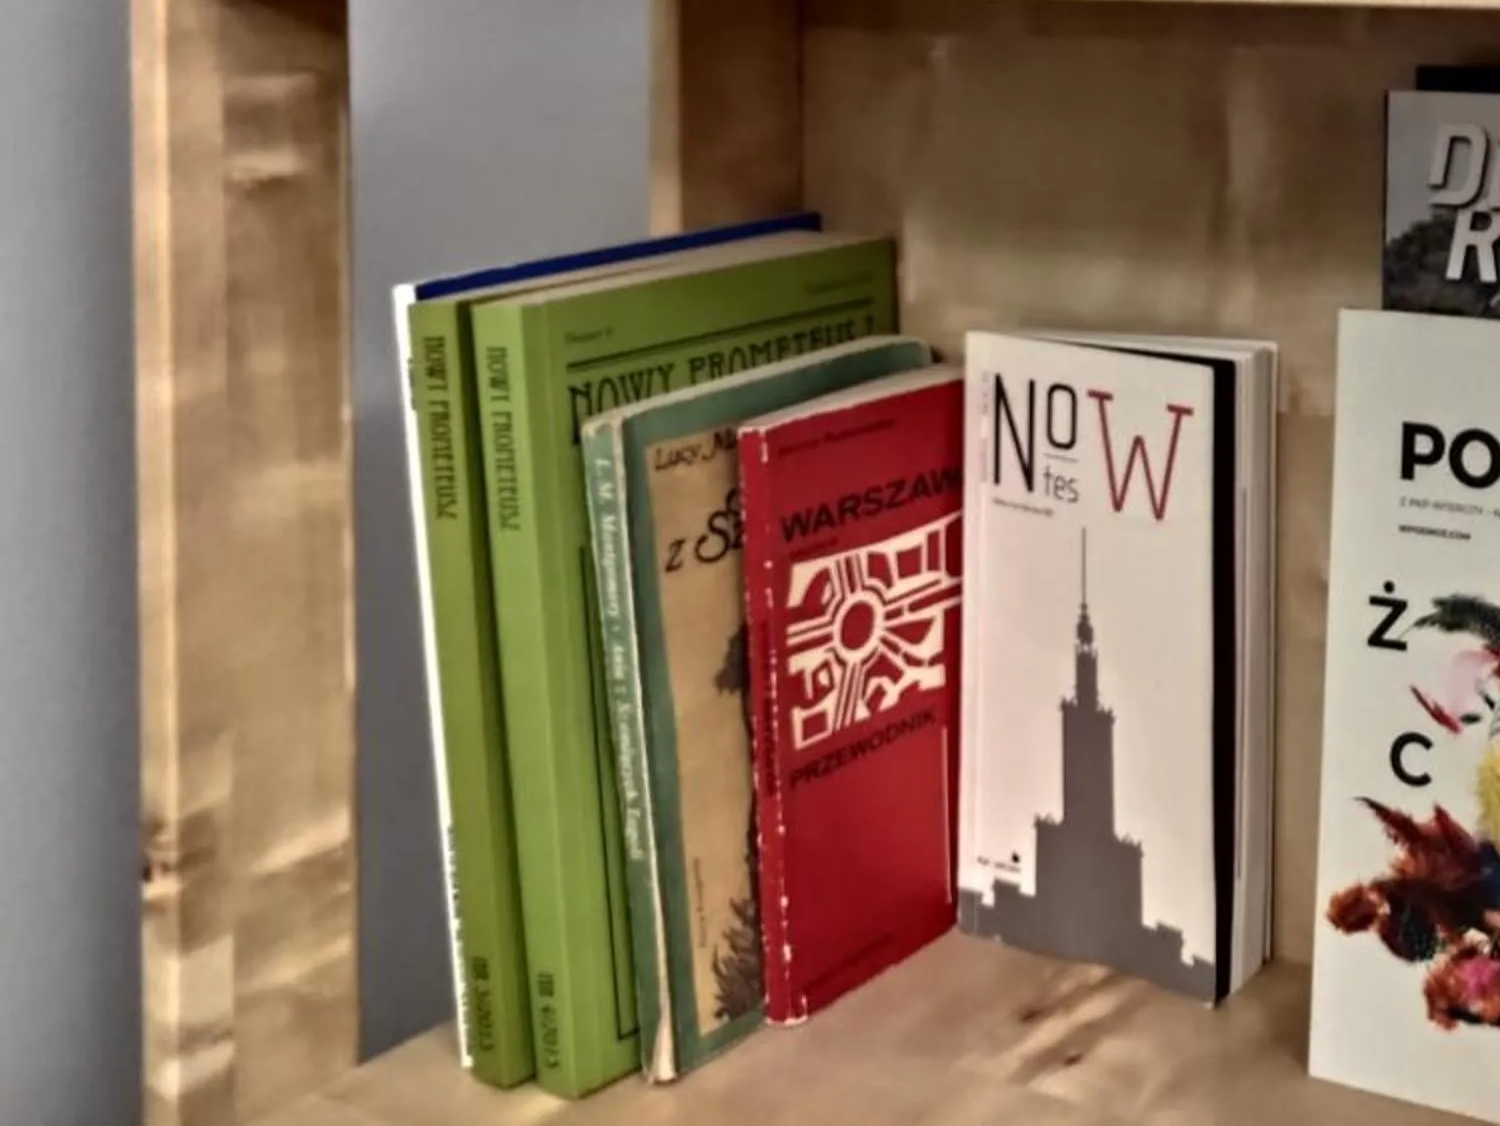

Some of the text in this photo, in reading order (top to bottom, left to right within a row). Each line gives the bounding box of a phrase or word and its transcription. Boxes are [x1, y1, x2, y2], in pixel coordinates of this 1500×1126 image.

[781, 467, 965, 544] WARSZAW
[789, 707, 936, 791] PRZEWODNIK
[1389, 731, 1434, 788] C
